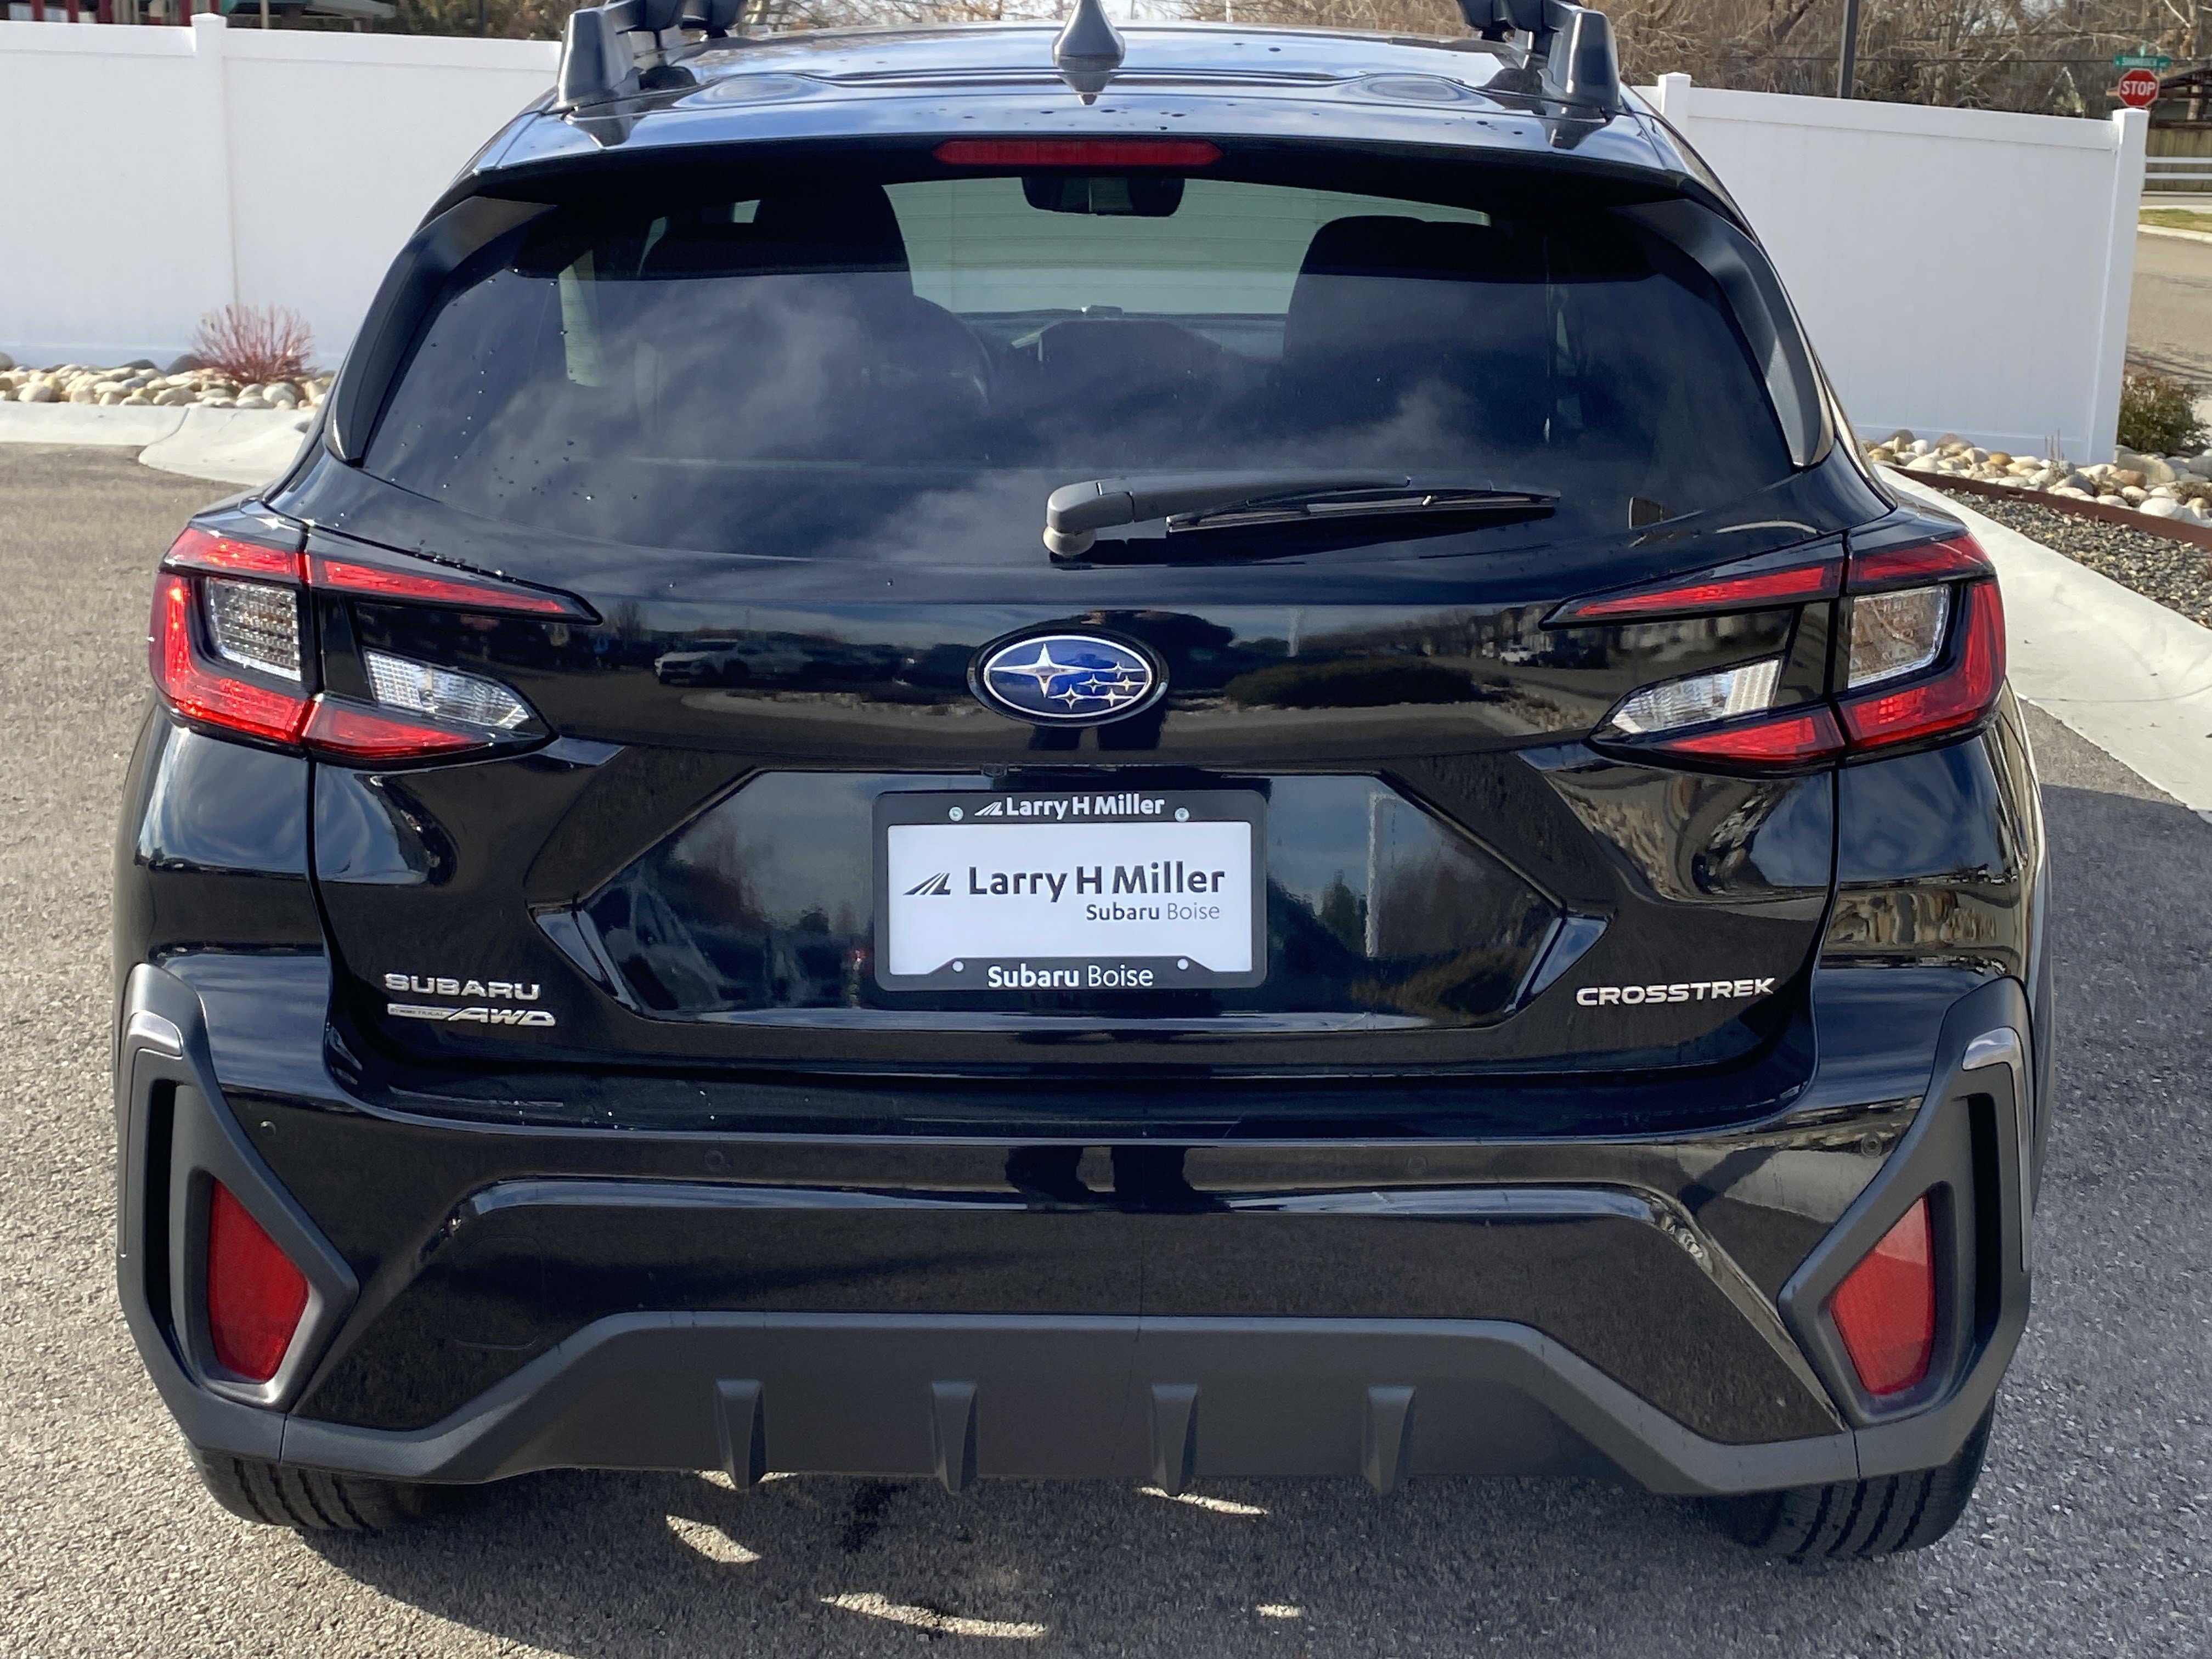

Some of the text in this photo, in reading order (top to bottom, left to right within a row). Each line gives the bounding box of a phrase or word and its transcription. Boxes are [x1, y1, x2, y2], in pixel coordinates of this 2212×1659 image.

[2121, 81, 2156, 96] STOP
[1006, 793, 1165, 820] Larry H Miller
[969, 861, 1225, 903] Larry H Miller
[1086, 901, 1220, 921] Subaru Boise
[384, 973, 541, 1001] SUBARU
[988, 963, 1154, 988] Subaru Boise
[1576, 977, 1776, 1006] CROSSTREK
[447, 1007, 556, 1026] AWD
